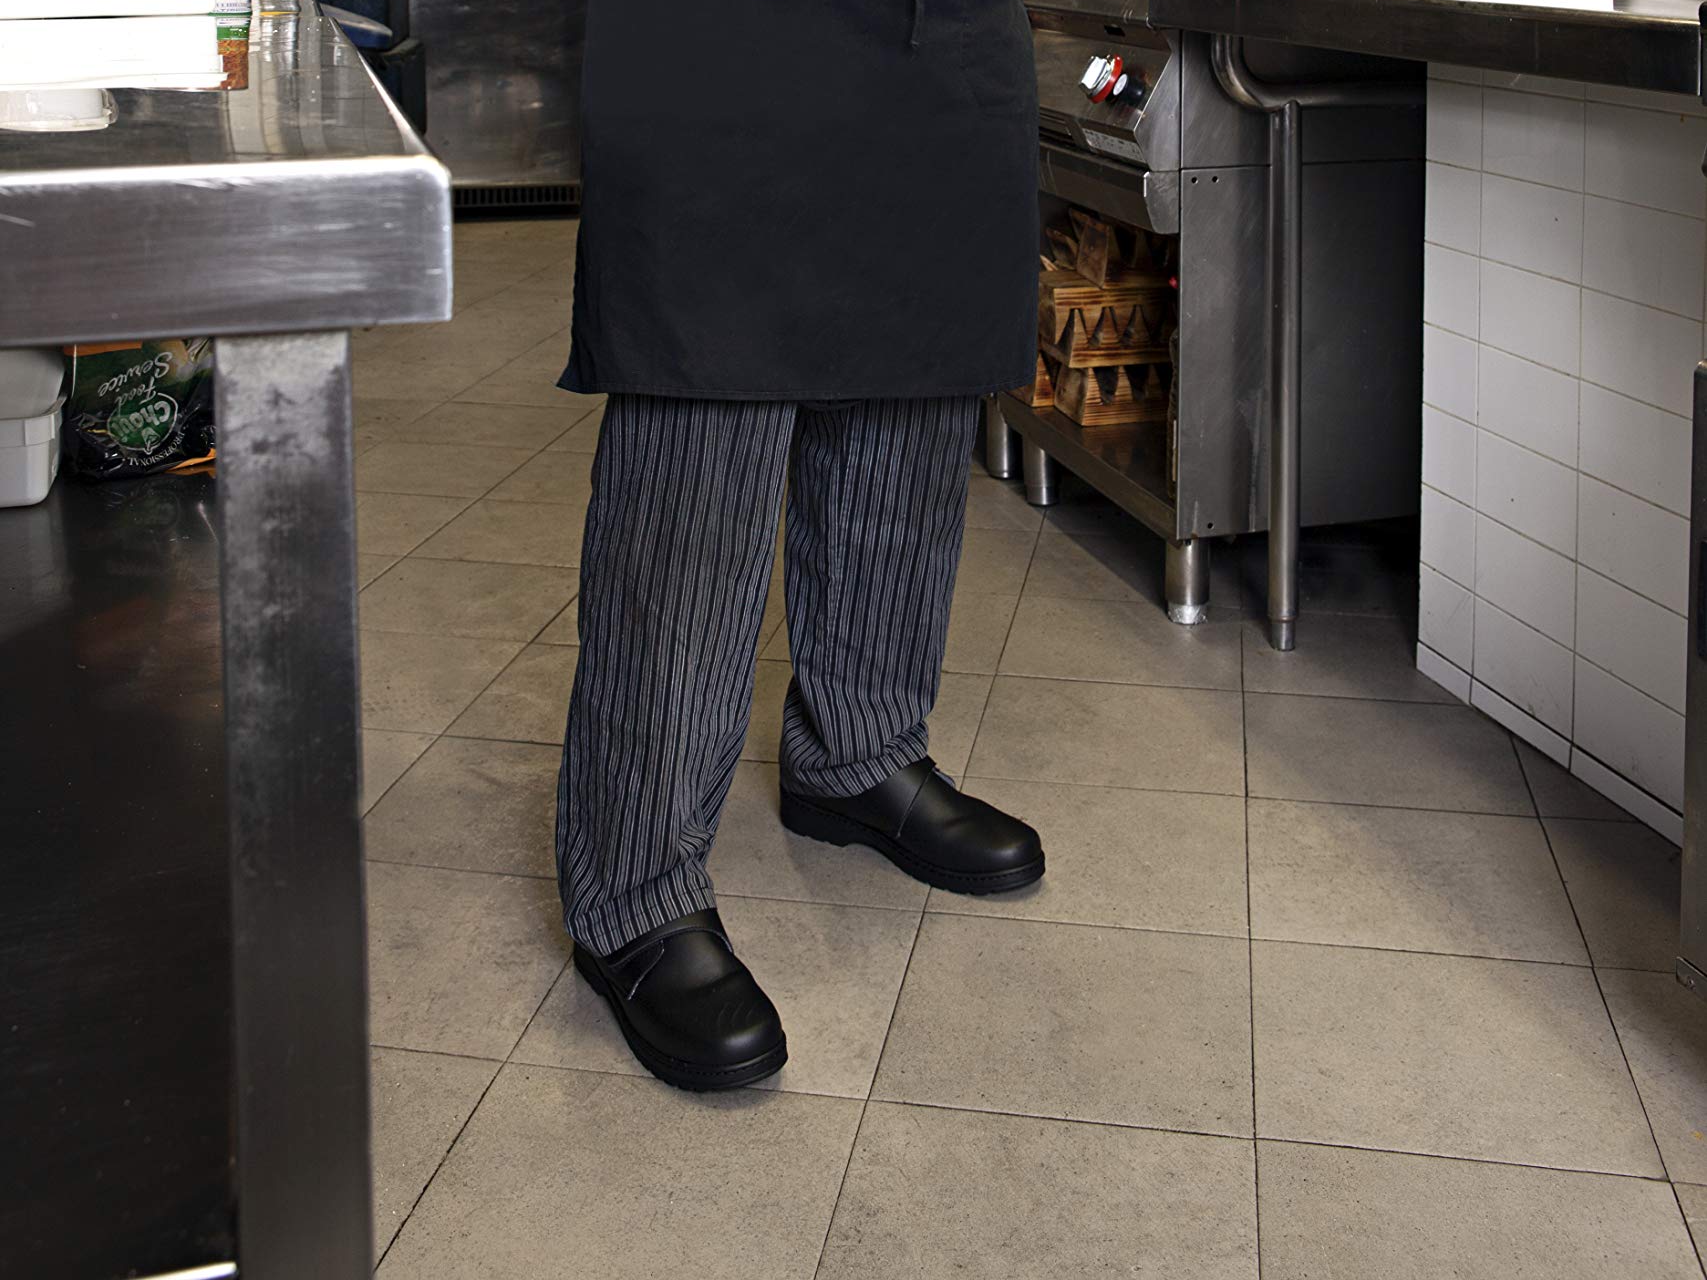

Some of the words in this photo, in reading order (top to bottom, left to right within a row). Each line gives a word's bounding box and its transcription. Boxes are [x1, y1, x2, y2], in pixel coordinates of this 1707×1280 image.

[97, 351, 174, 398] Service
[114, 377, 159, 414] Food
[128, 430, 187, 467] PROFESSIONAL
